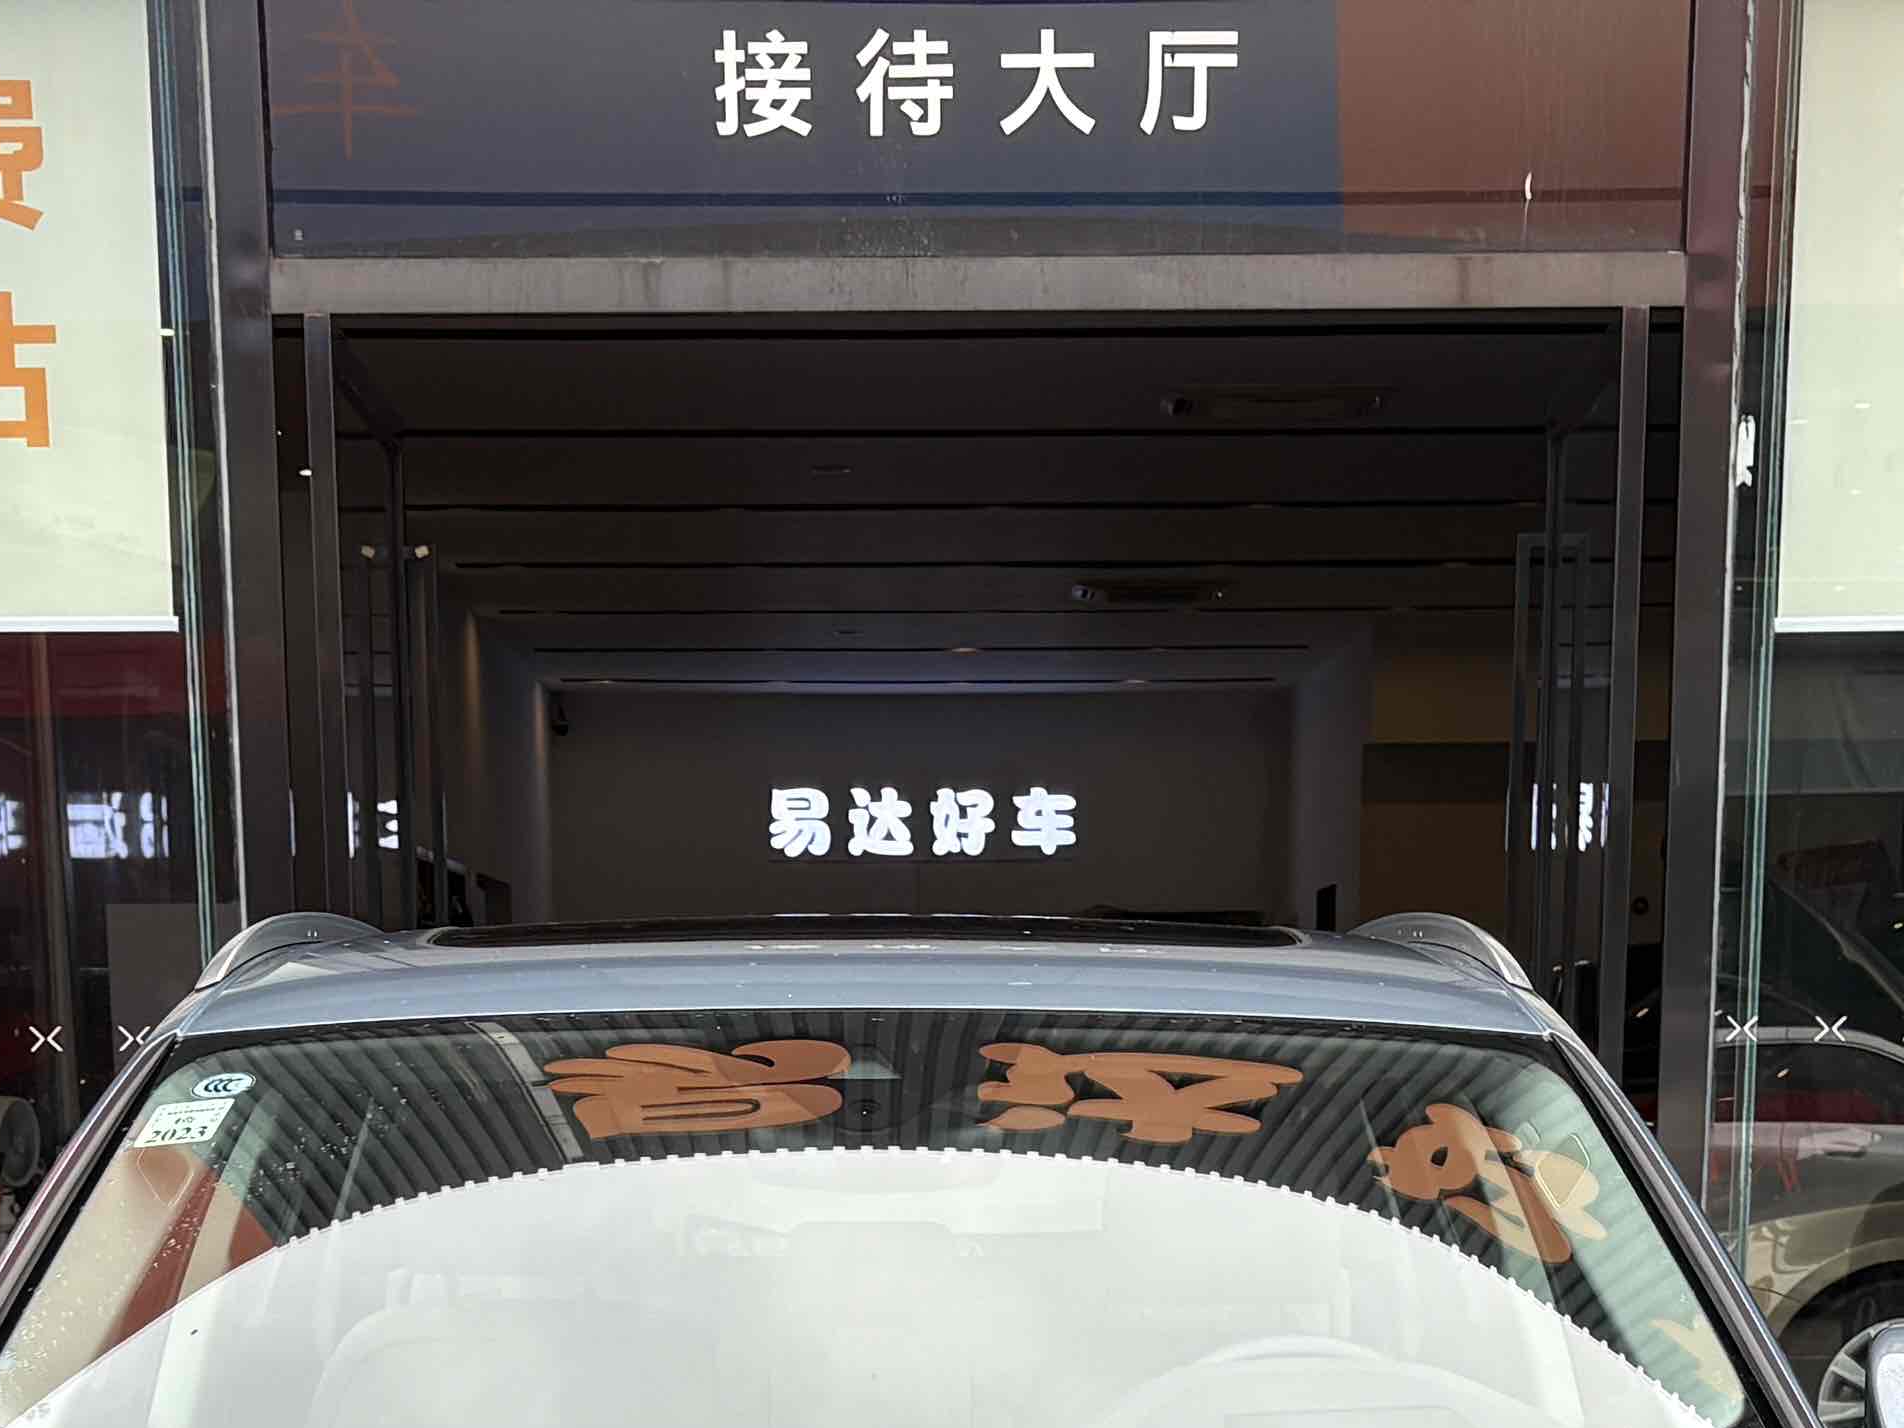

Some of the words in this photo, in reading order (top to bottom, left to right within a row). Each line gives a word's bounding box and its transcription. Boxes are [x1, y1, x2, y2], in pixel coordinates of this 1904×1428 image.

[713, 28, 1240, 138] 接待大厅
[767, 786, 1078, 858] 易达好车
[143, 1125, 208, 1144] 2023
